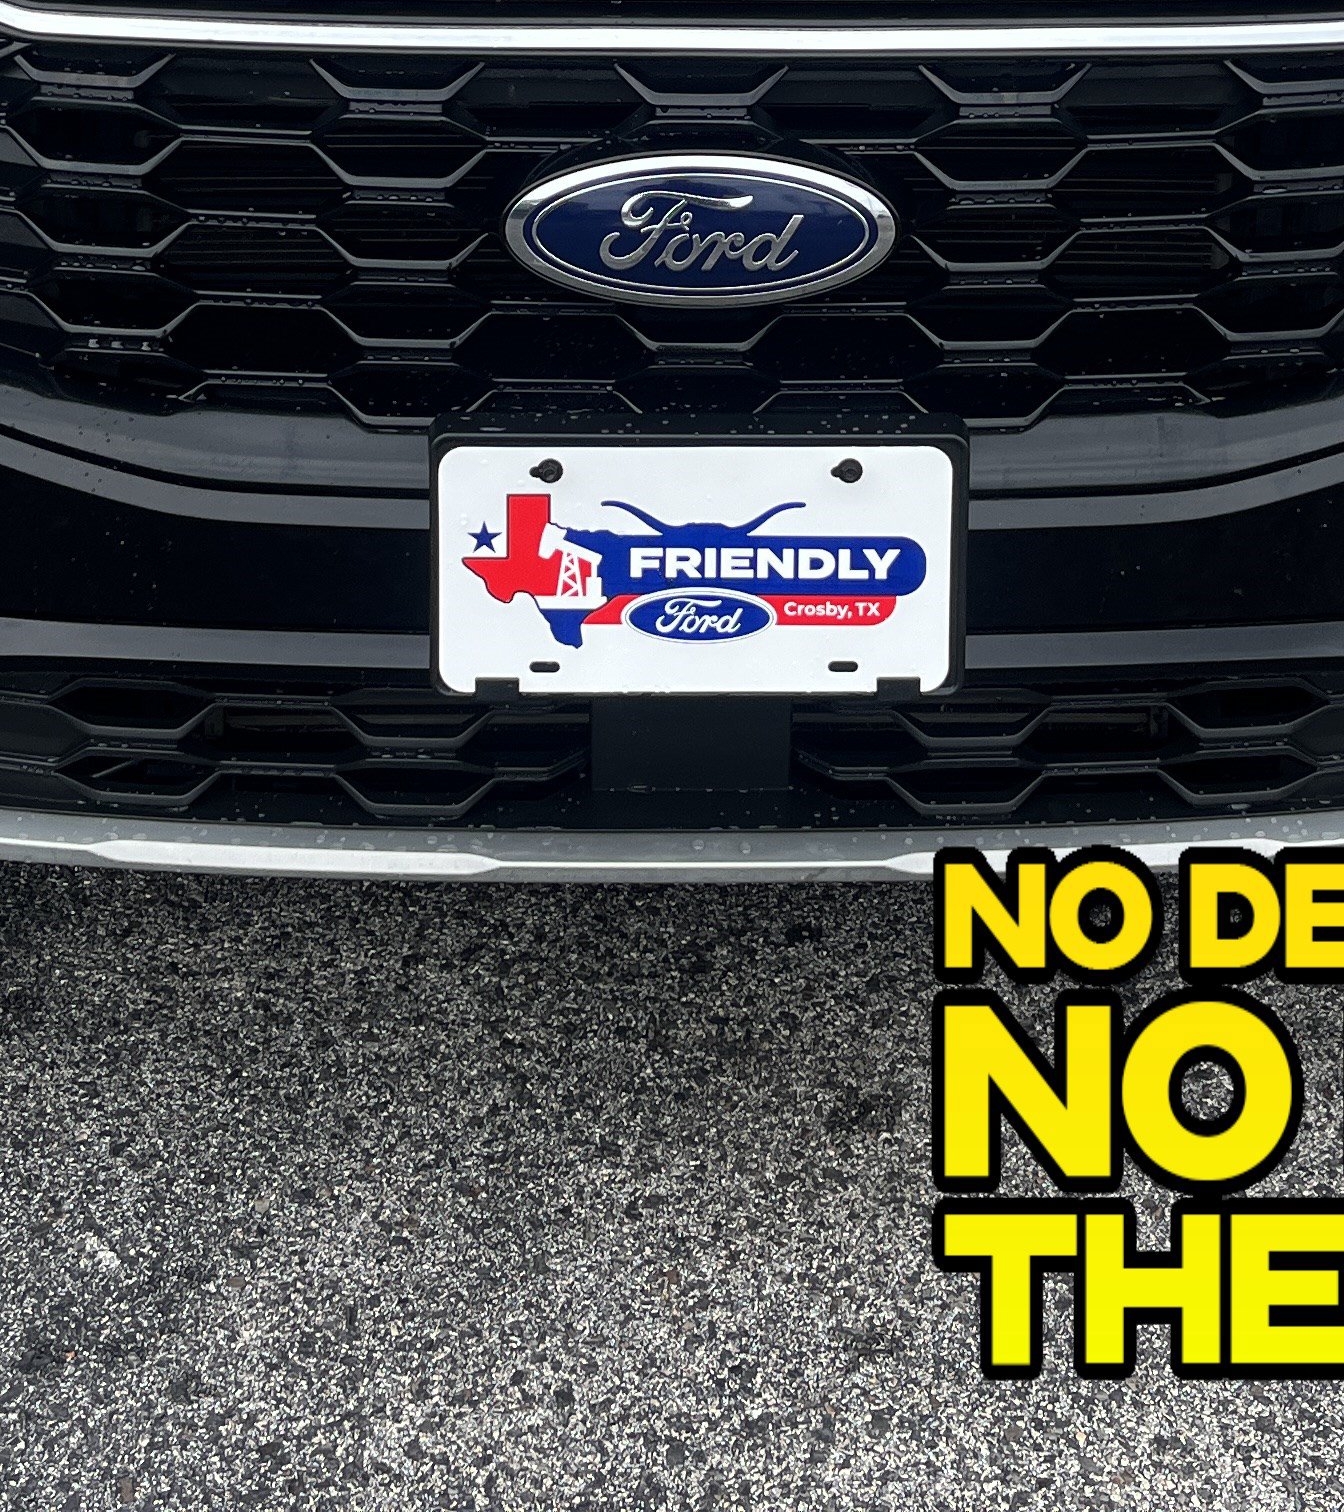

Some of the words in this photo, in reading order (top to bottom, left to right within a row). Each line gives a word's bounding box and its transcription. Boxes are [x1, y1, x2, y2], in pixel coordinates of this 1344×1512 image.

[598, 189, 806, 272] Ford
[629, 547, 902, 580] FRIENDLY
[654, 596, 745, 634] Ford
[783, 601, 853, 620] Crosby,
[854, 601, 881, 618] TX
